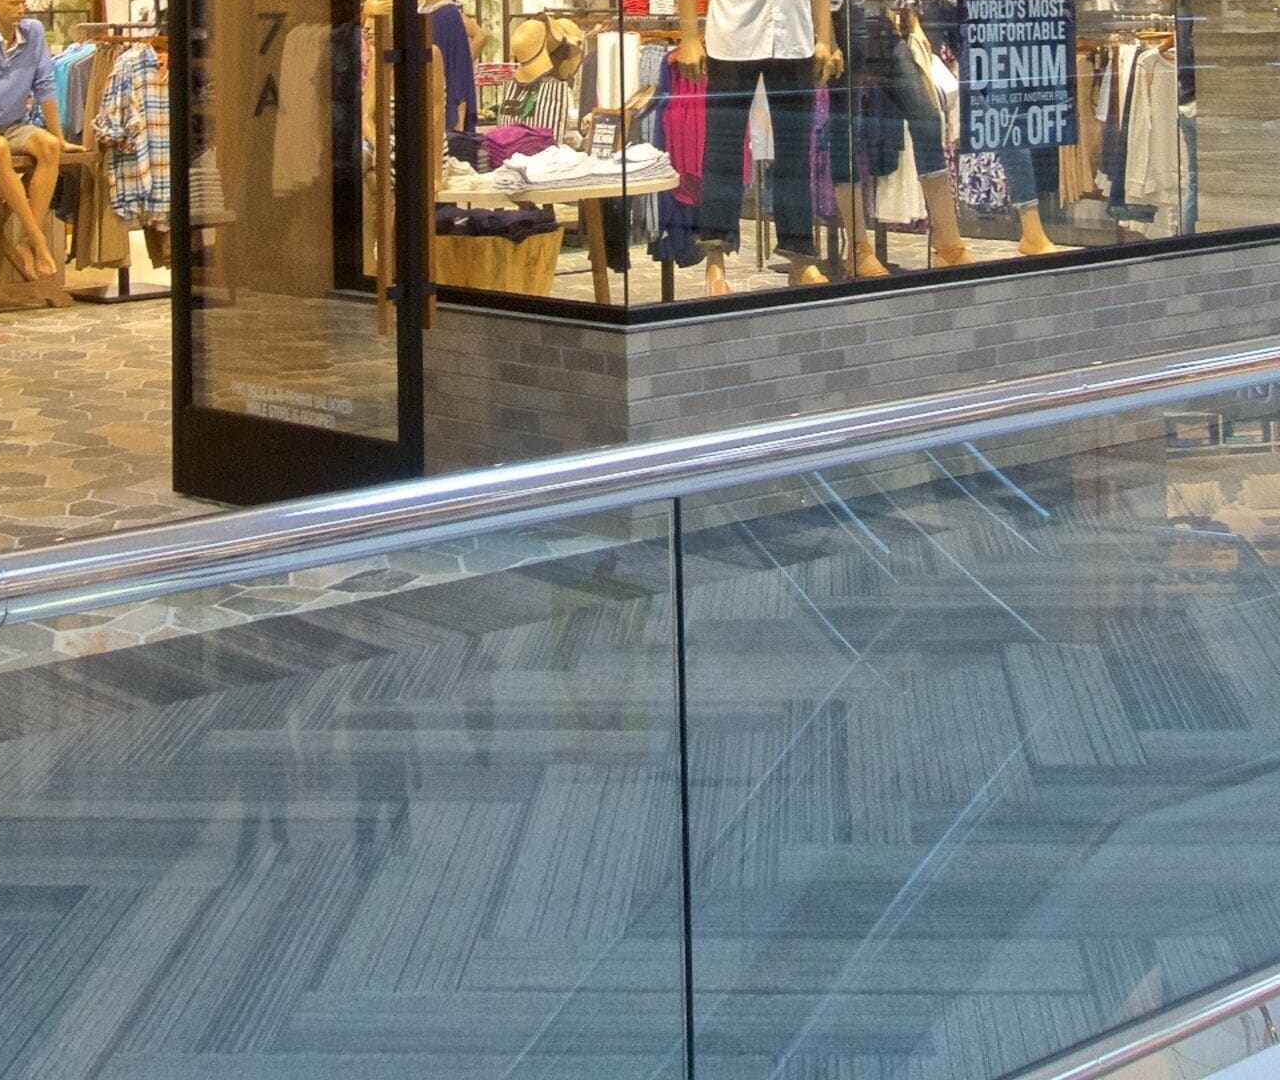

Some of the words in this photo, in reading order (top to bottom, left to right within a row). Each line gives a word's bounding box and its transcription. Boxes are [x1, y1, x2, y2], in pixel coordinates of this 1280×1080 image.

[967, 0, 1026, 20] WORLD'S
[968, 21, 1066, 44] COMFORTABLE
[970, 44, 1067, 90] DENIM
[1009, 92, 1023, 104] GET
[1023, 91, 1055, 103] ANOTHER
[1055, 89, 1068, 101] FOR
[970, 107, 1021, 150] 50%
